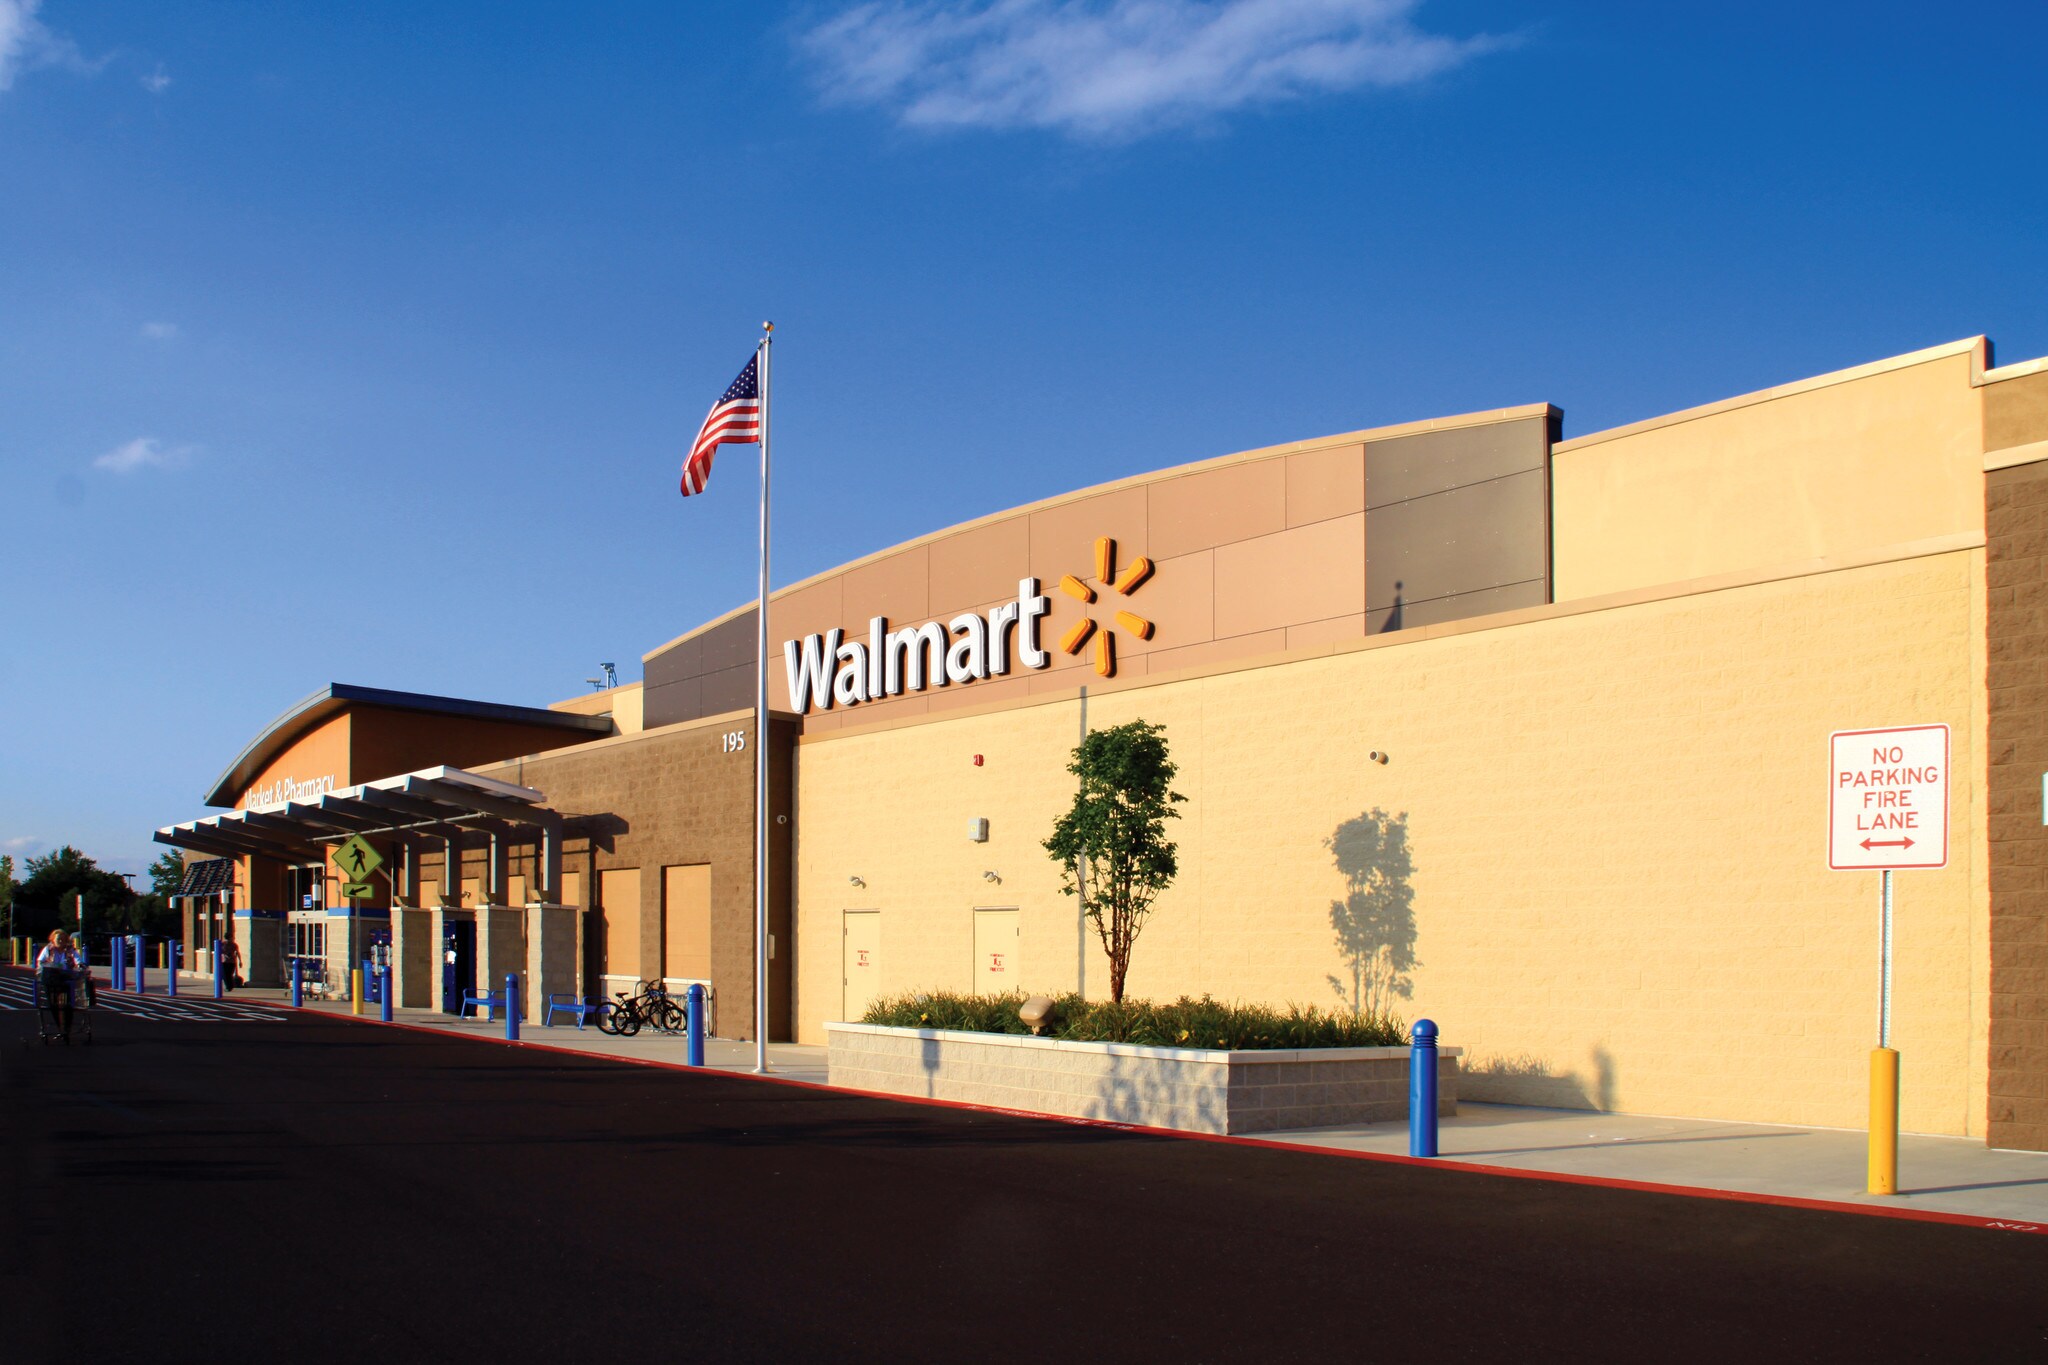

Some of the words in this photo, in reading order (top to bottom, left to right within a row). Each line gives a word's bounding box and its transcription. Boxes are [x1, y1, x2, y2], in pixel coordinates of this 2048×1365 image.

[784, 576, 1046, 714] Walmart
[722, 731, 745, 753] 195
[1873, 746, 1903, 764] NO
[1839, 766, 1938, 788] PARKING
[245, 784, 274, 809] Market
[275, 780, 283, 802] &
[284, 774, 335, 800] Pharmacy
[1864, 790, 1912, 808] FIRE
[1857, 811, 1919, 830] LANE
[1985, 1221, 2039, 1231] NO
